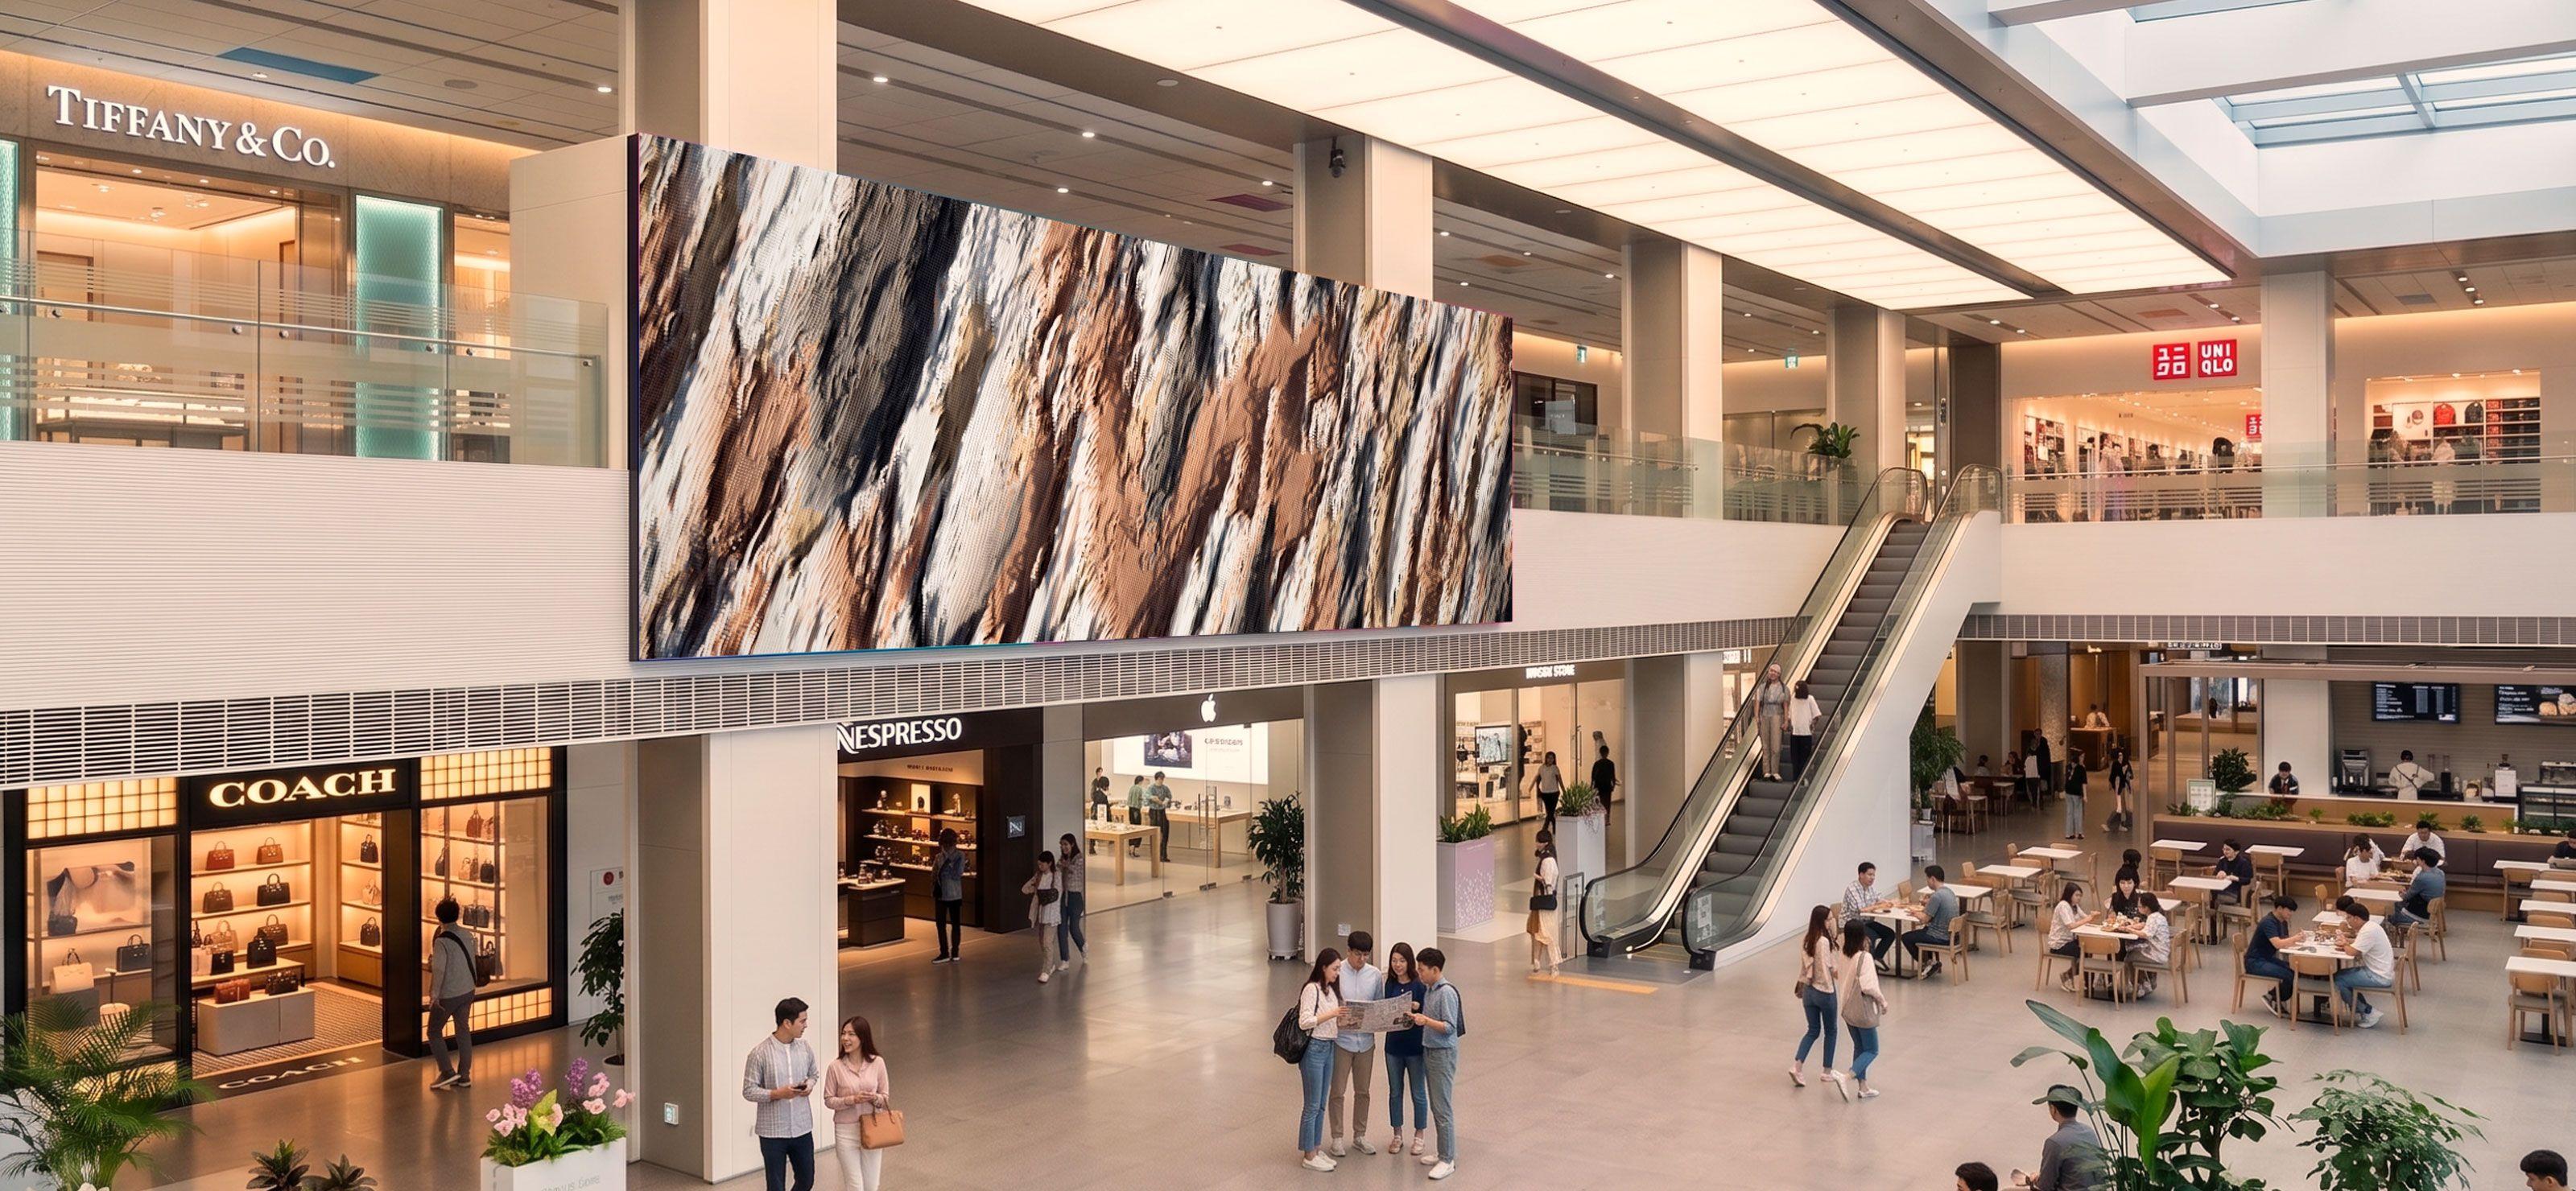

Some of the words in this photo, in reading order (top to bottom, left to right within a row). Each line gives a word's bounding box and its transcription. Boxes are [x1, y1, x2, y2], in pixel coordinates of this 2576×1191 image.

[47, 84, 233, 150] TIFFANY
[837, 717, 962, 755] NESPRESSO
[208, 768, 397, 808] COACH
